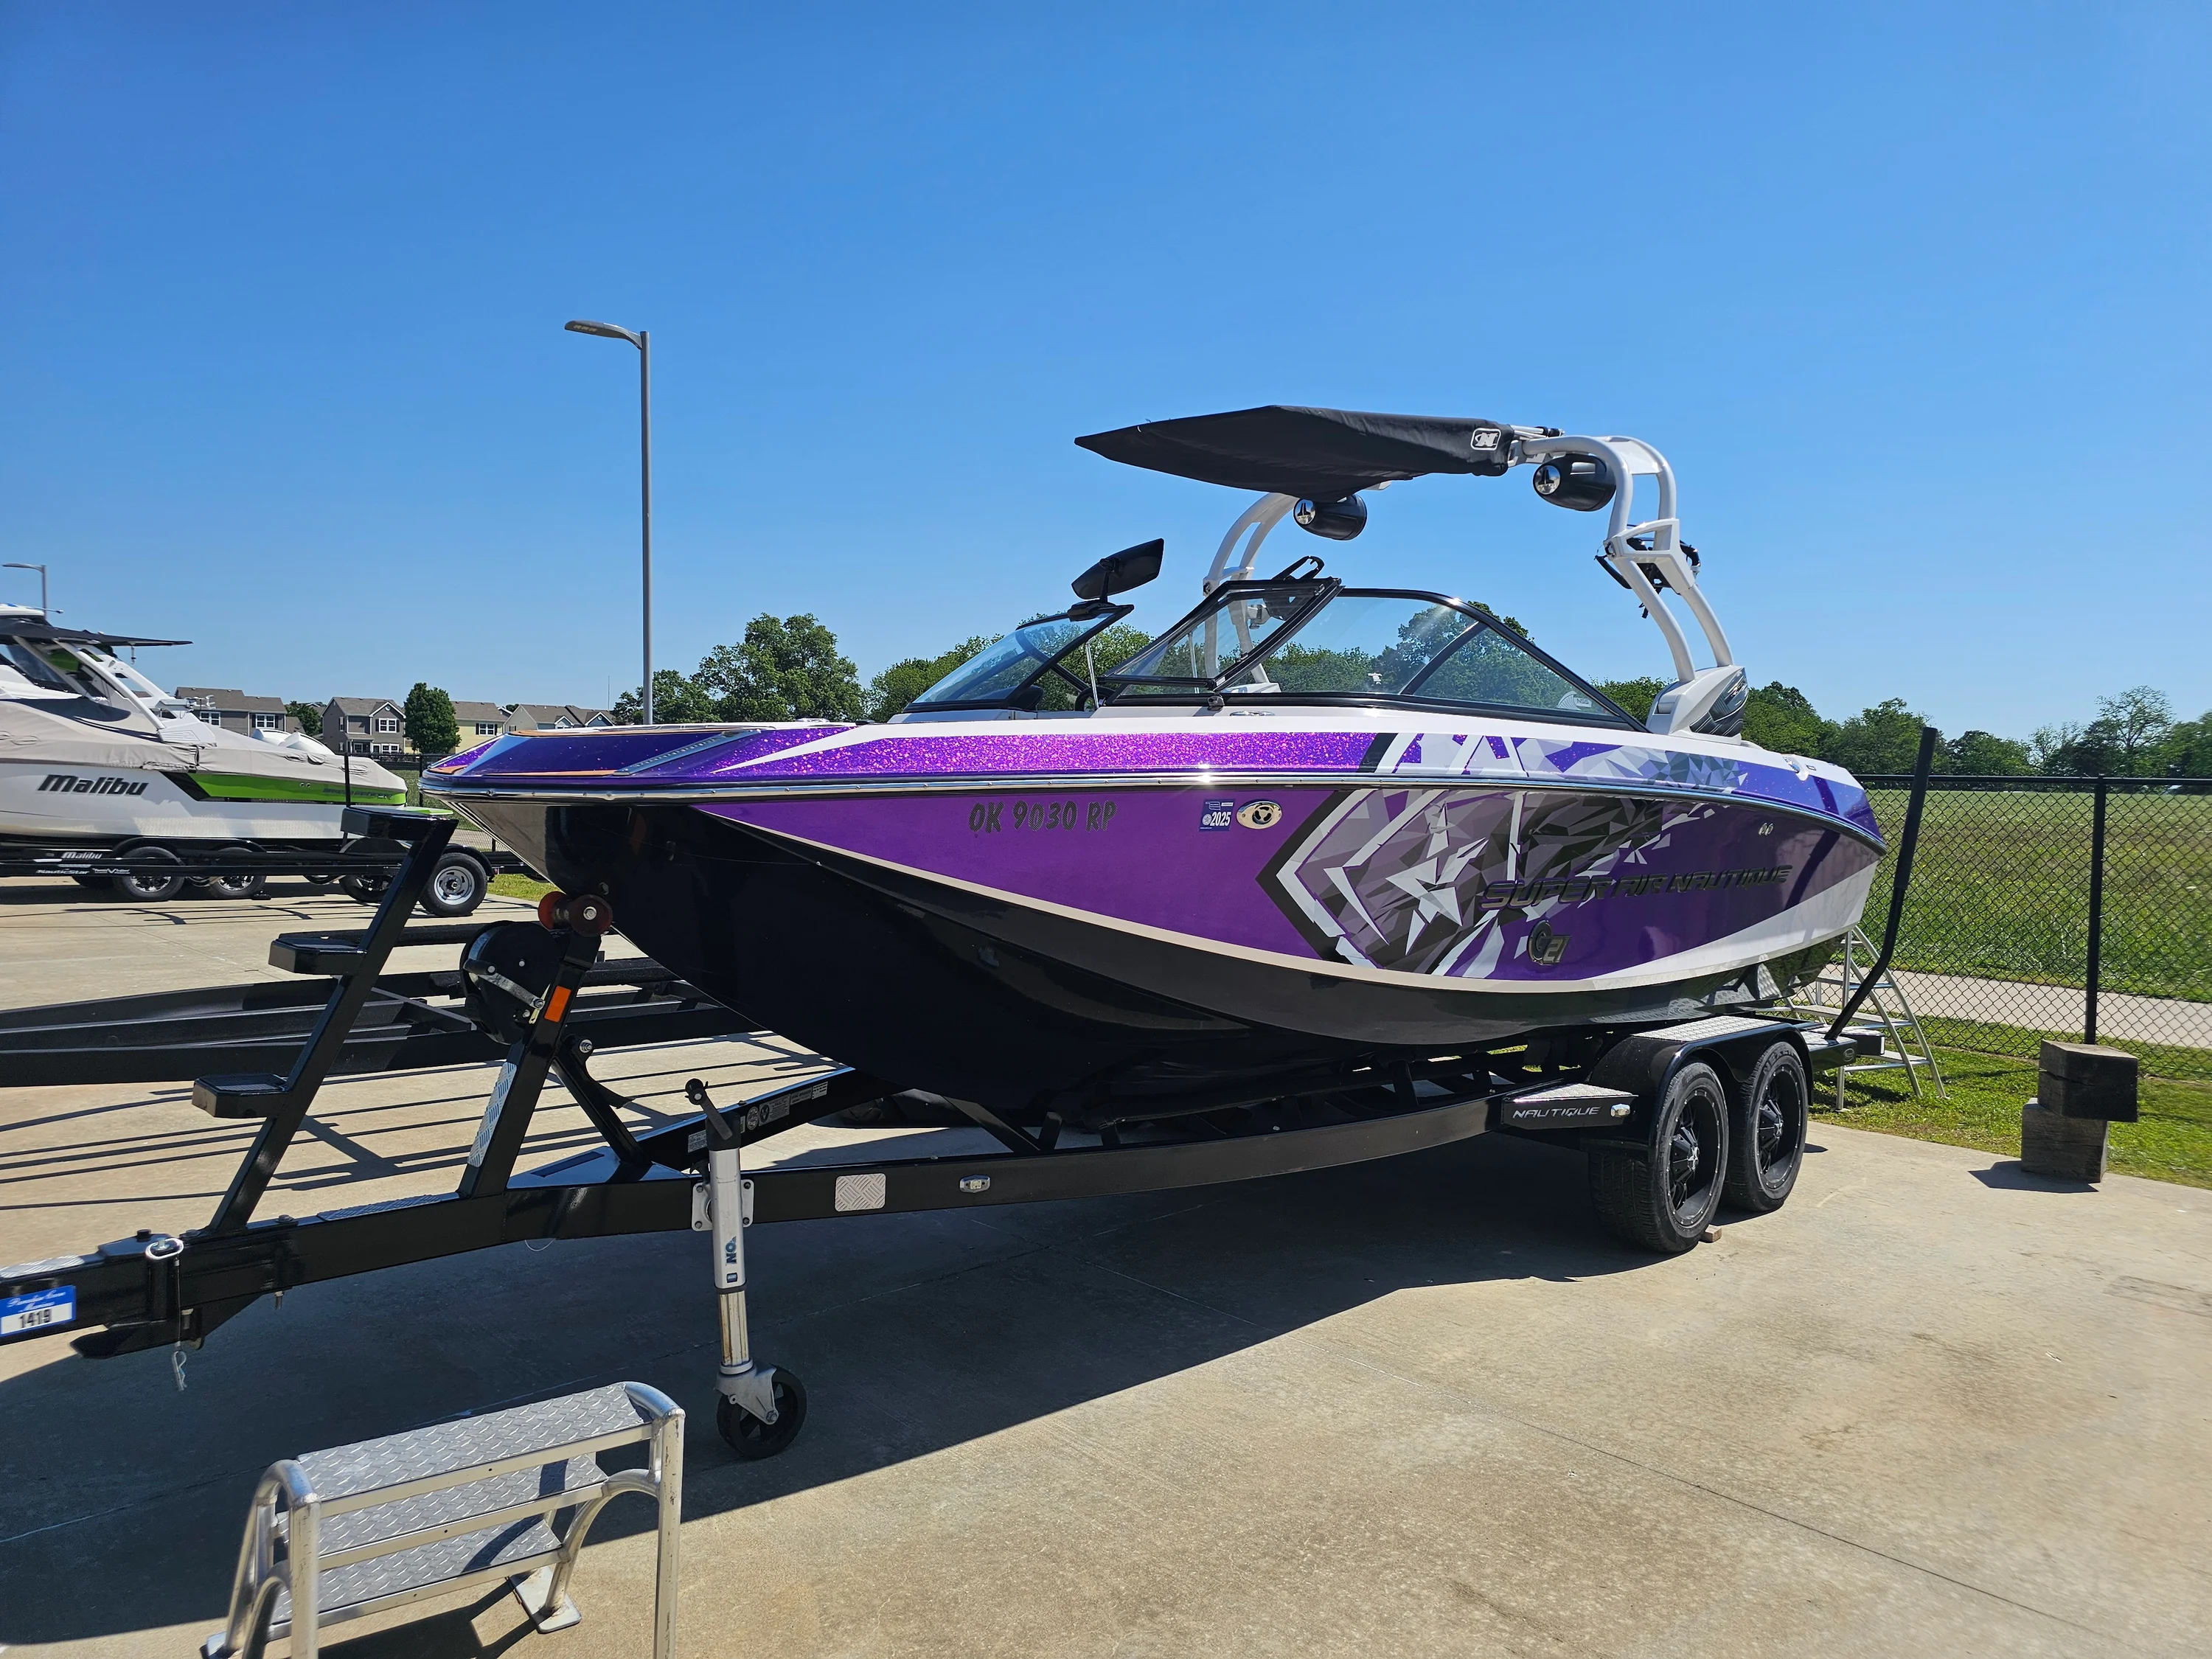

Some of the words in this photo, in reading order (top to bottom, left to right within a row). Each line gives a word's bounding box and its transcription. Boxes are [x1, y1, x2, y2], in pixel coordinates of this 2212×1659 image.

[38, 774, 149, 796] Malibu
[969, 801, 1004, 834] OK
[1012, 800, 1078, 832] 9030
[1085, 800, 1118, 832] RP
[1209, 811, 1231, 827] 2025
[61, 851, 102, 860] Malibu
[1480, 875, 1613, 909] SUPER
[1610, 873, 1669, 898] AIR
[1666, 864, 1793, 894] NAUTIQUE
[1512, 1106, 1601, 1119] NAUTIQUE
[18, 1309, 52, 1329] 1419
